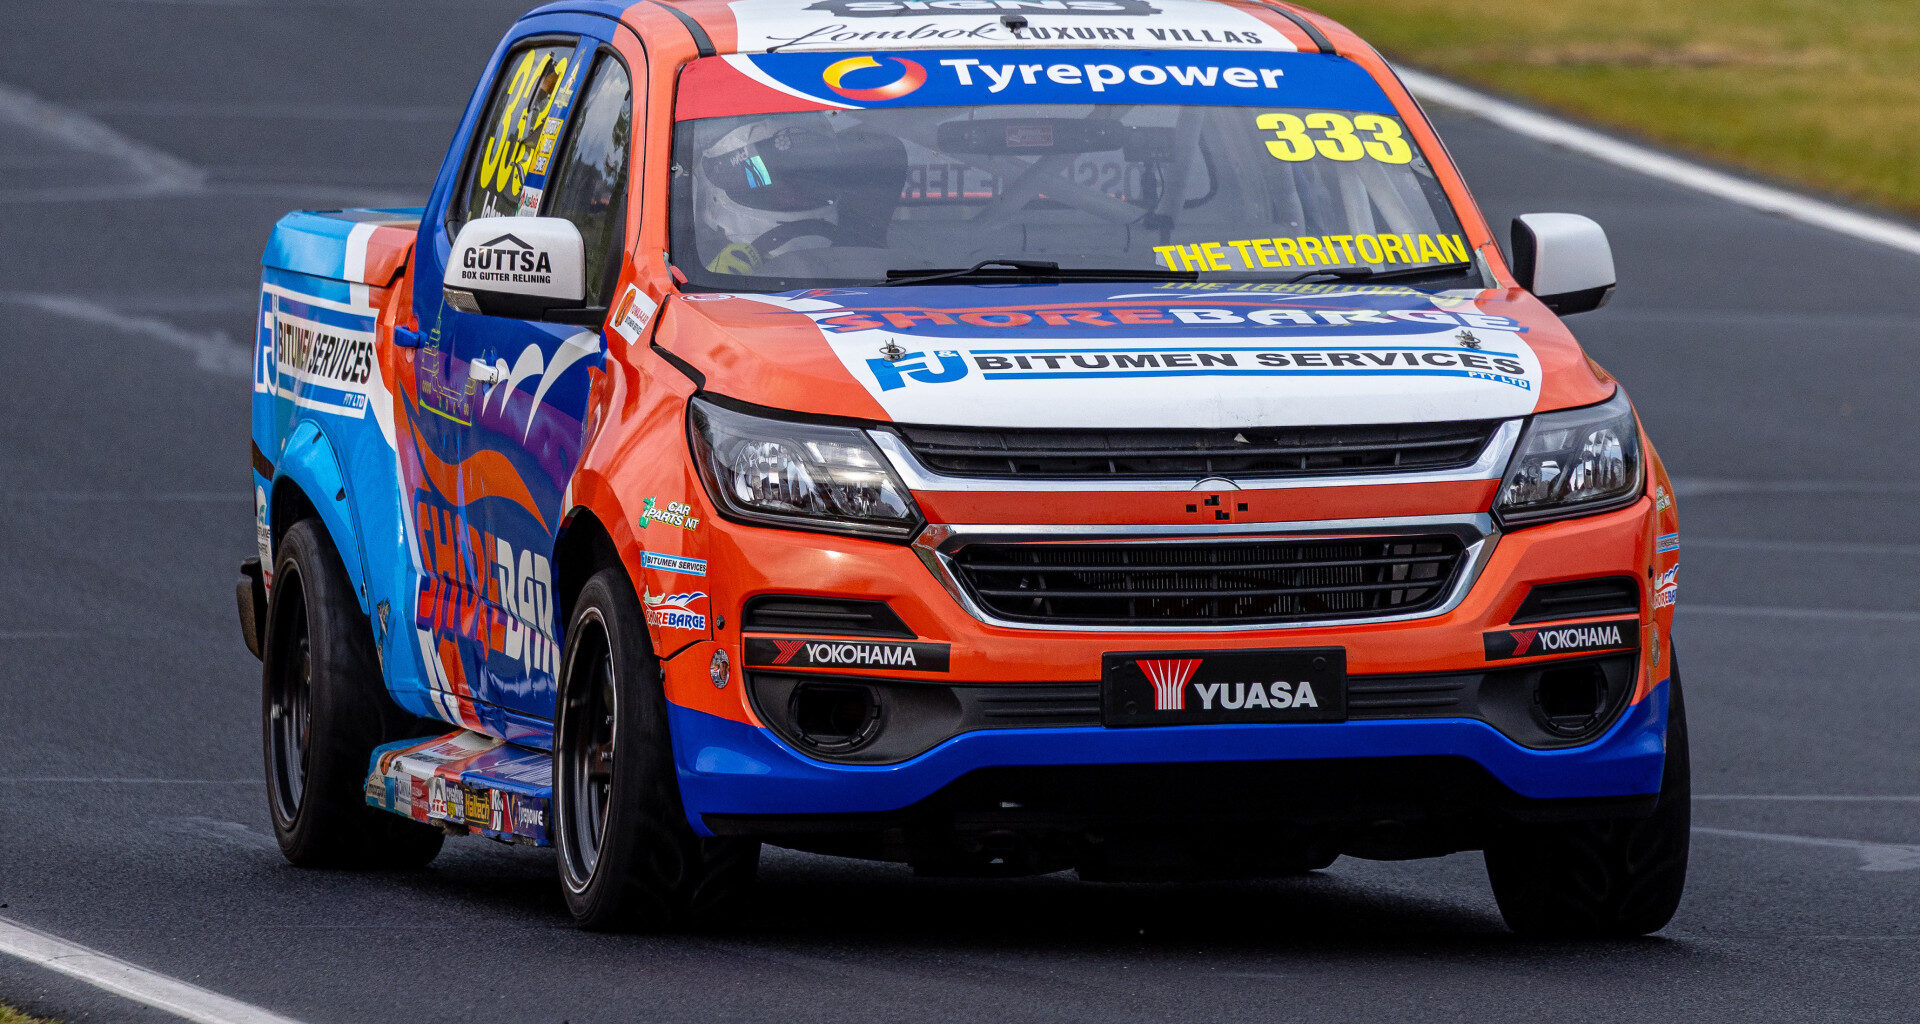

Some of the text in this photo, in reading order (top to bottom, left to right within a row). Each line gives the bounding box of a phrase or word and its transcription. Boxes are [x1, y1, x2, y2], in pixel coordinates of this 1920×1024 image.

[766, 22, 1003, 51] Lombok
[1146, 28, 1263, 45] VILLAS
[940, 58, 1285, 93] Tyrepower
[1255, 112, 1414, 164] 333
[463, 247, 552, 274] GUTTSA
[1153, 233, 1470, 273] THE TERRITORIAN
[461, 270, 551, 284] BOX GUTTER RELINING
[823, 304, 1521, 335] SHOREBARGE
[278, 321, 315, 372] BITUMEN
[307, 332, 373, 385] SERVICES
[973, 353, 1238, 371] BITUMEN
[1255, 352, 1526, 376] SERVICES
[1468, 371, 1529, 388] PTY LTD
[353, 395, 364, 408] LTD
[647, 507, 700, 531] PARTS NT
[667, 501, 691, 516] CAR
[647, 556, 677, 568] BITUMEN
[678, 559, 706, 573] SERVICES
[1538, 625, 1622, 650] YOKOHAMA
[805, 643, 917, 667] YOKOHAMA
[1194, 681, 1319, 710] YUASA
[465, 792, 491, 819] Haltech
